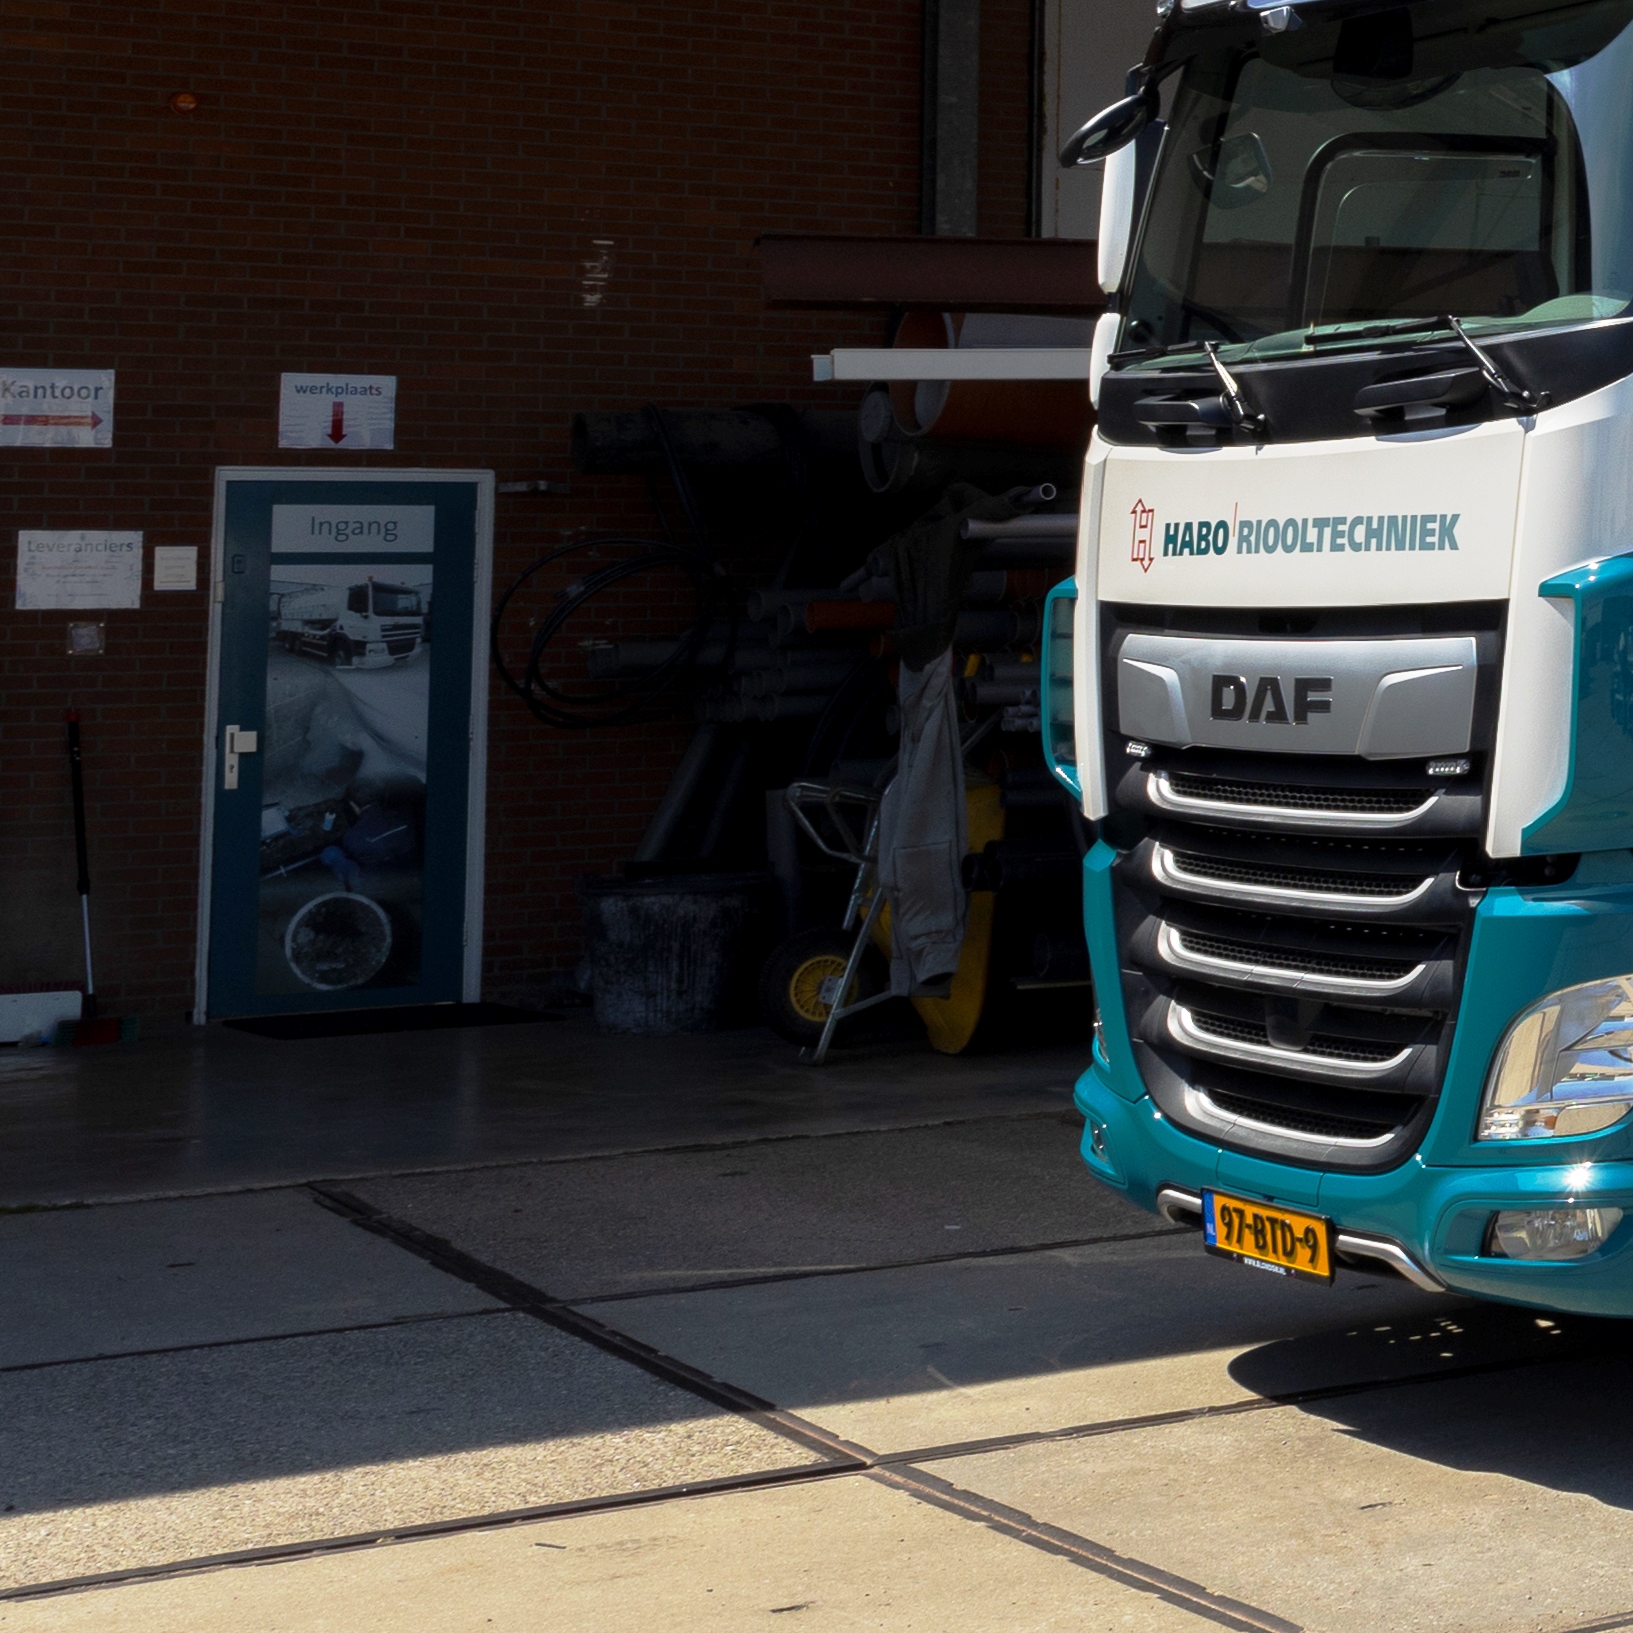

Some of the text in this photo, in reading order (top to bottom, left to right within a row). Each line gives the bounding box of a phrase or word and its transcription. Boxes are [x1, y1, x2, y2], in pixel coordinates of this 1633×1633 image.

[1, 380, 105, 401] Kantoor
[294, 382, 383, 398] werkplaats
[310, 516, 399, 542] Ingang
[1163, 514, 1461, 557] HABO RIOOLTECHNIEK
[27, 539, 134, 554] Leveranciers
[1210, 674, 1334, 726] DAF
[1219, 1203, 1319, 1264] 97-BTD-9
